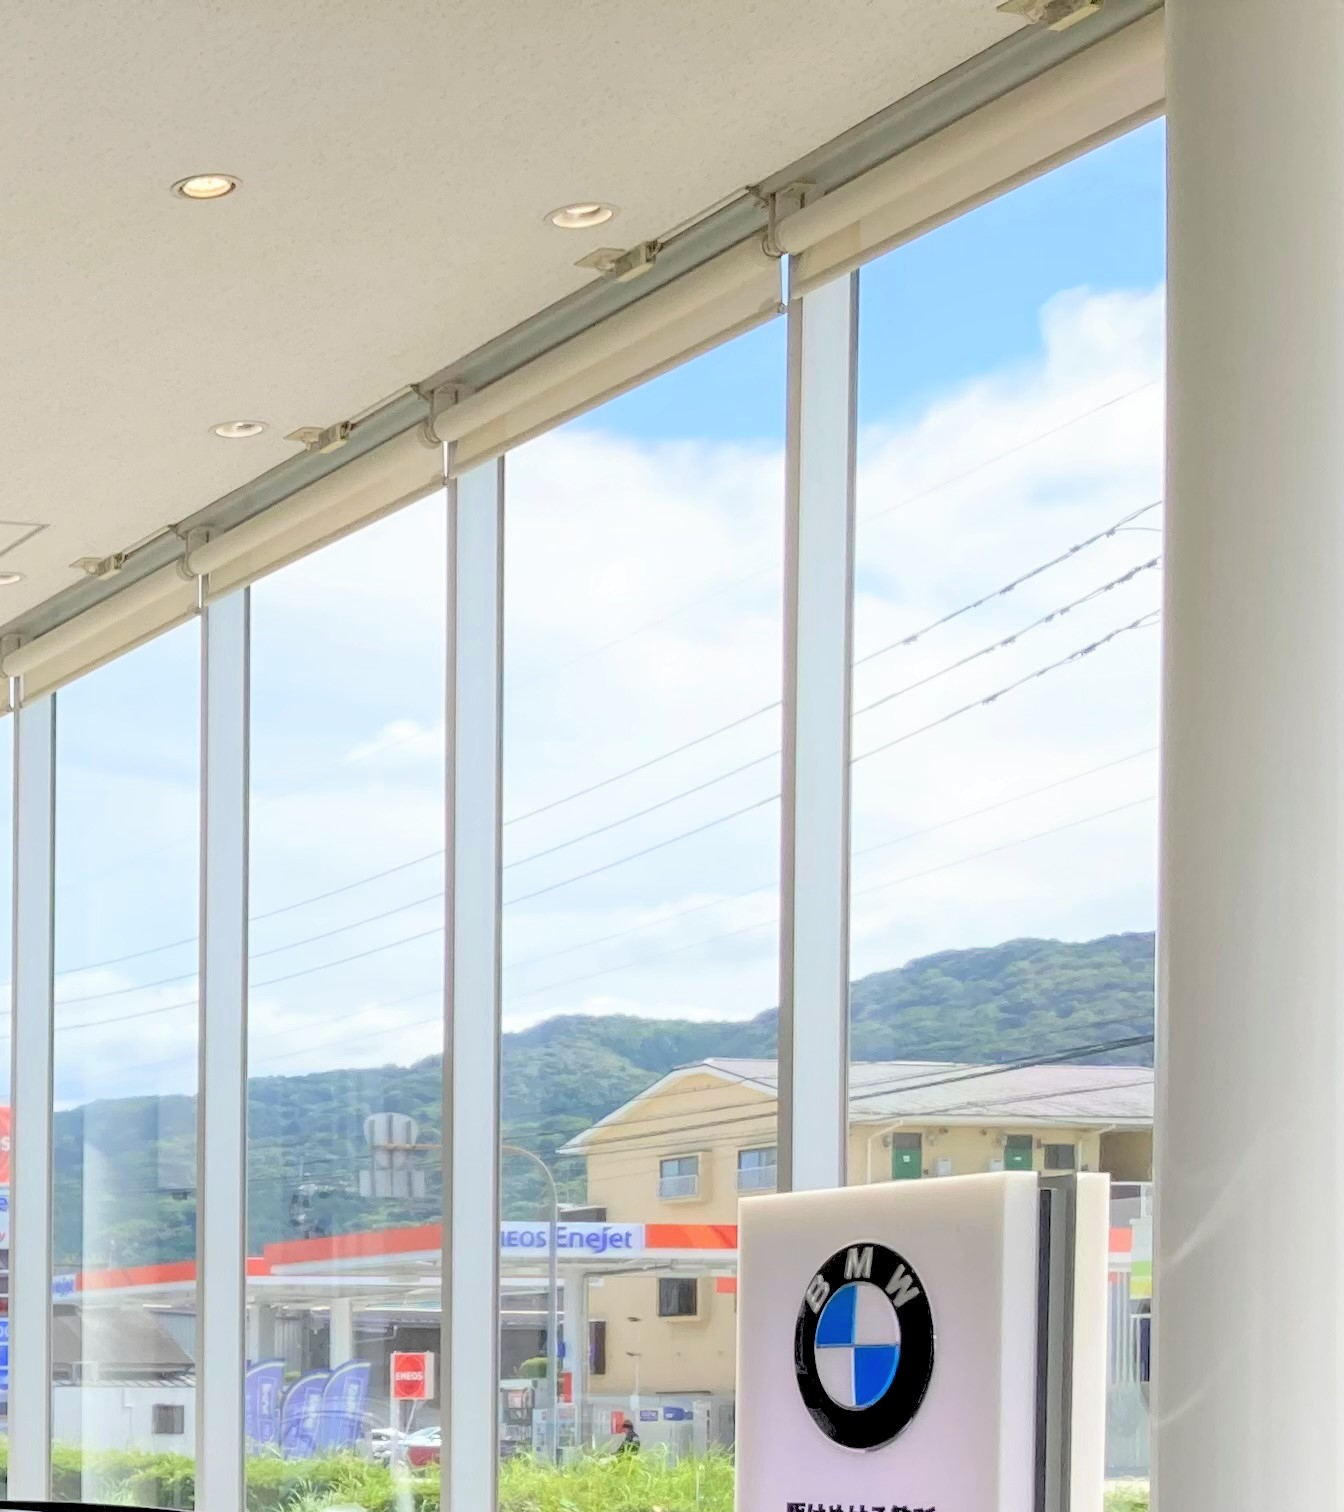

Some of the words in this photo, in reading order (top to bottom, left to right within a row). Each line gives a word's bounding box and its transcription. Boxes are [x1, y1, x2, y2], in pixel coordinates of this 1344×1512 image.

[556, 1226, 632, 1254] Enejet
[806, 1246, 921, 1314] BMW
[395, 1371, 423, 1381] ENEOS
